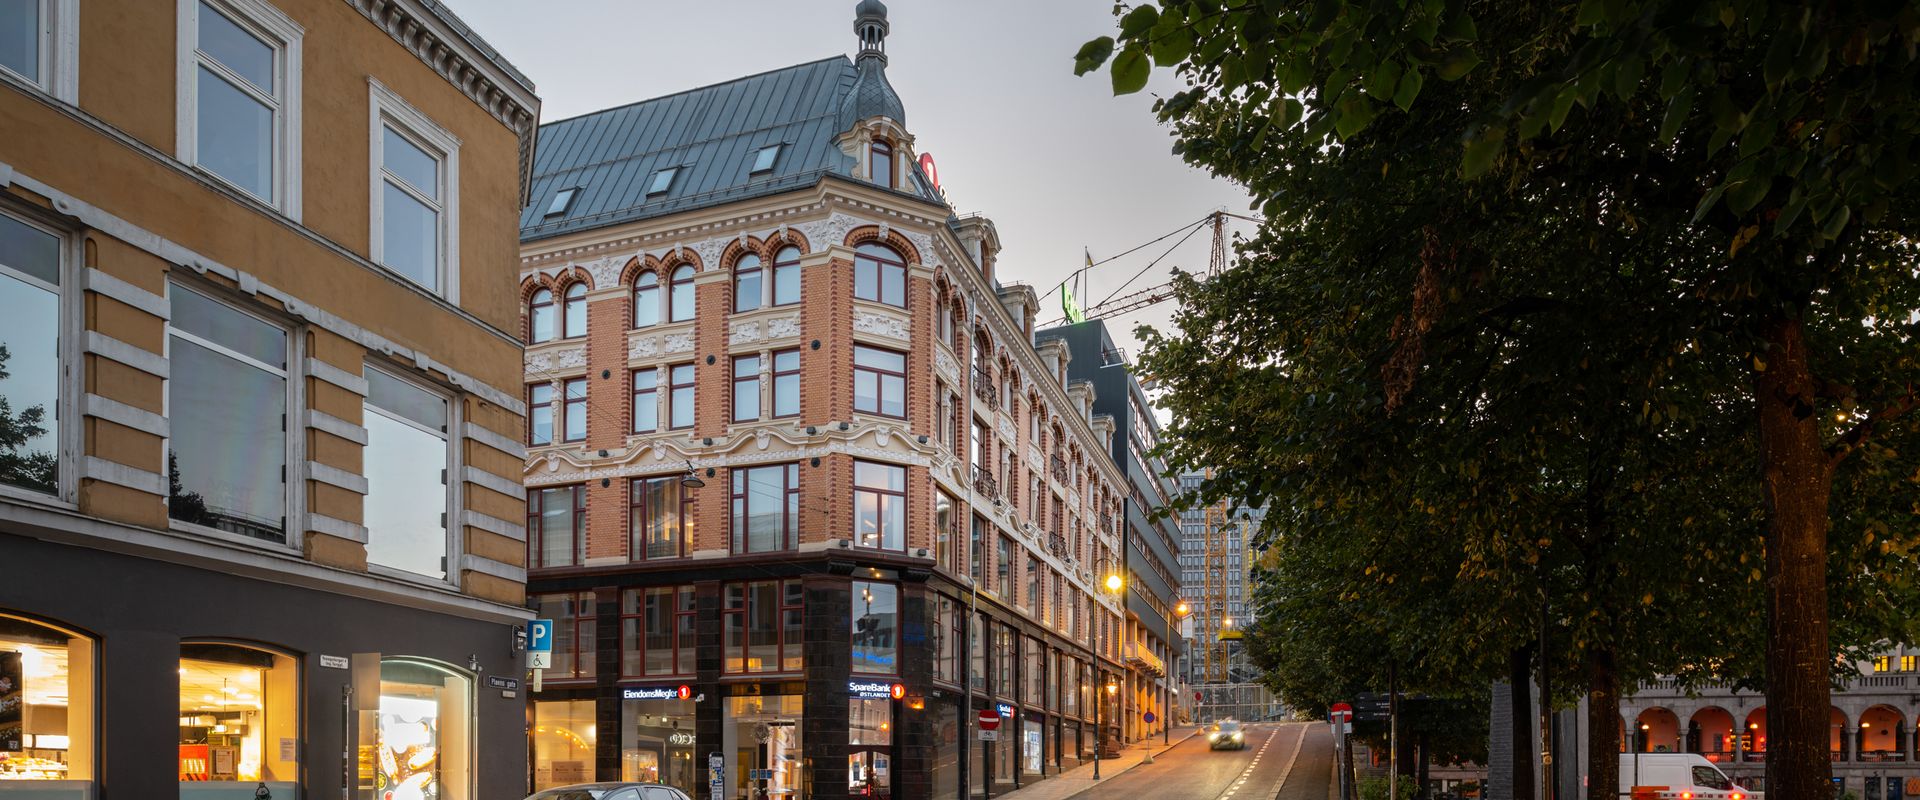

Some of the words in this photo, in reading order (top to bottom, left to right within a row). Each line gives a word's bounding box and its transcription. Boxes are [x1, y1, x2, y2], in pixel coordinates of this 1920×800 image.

[532, 624, 546, 647] P
[849, 682, 891, 692] SpareBank
[624, 689, 678, 699] EiendomsMegler
